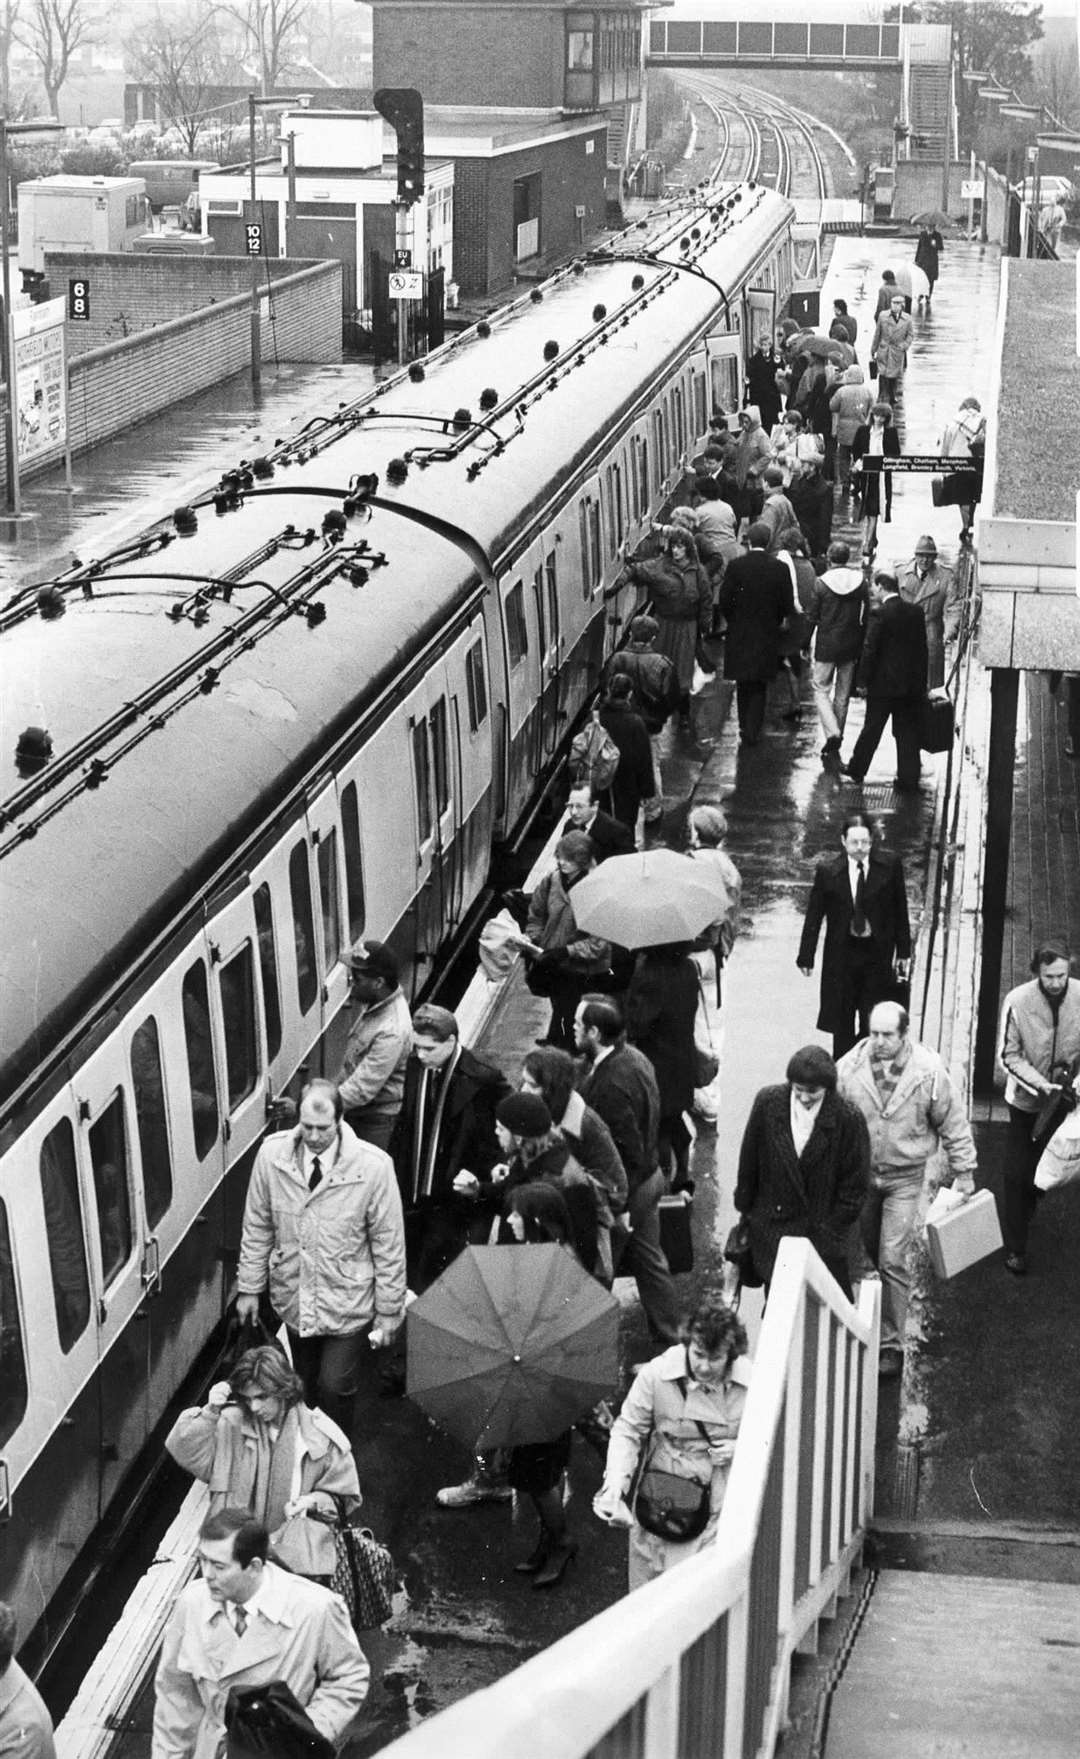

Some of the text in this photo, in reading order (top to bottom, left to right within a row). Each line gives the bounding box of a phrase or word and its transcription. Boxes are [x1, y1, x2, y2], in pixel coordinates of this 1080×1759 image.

[247, 225, 260, 237] 10
[248, 238, 260, 249] 12
[74, 282, 85, 297] 6
[74, 299, 85, 312] 8
[803, 299, 808, 312] 1
[913, 457, 939, 465] Chatham,
[911, 464, 933, 472] Bromley
